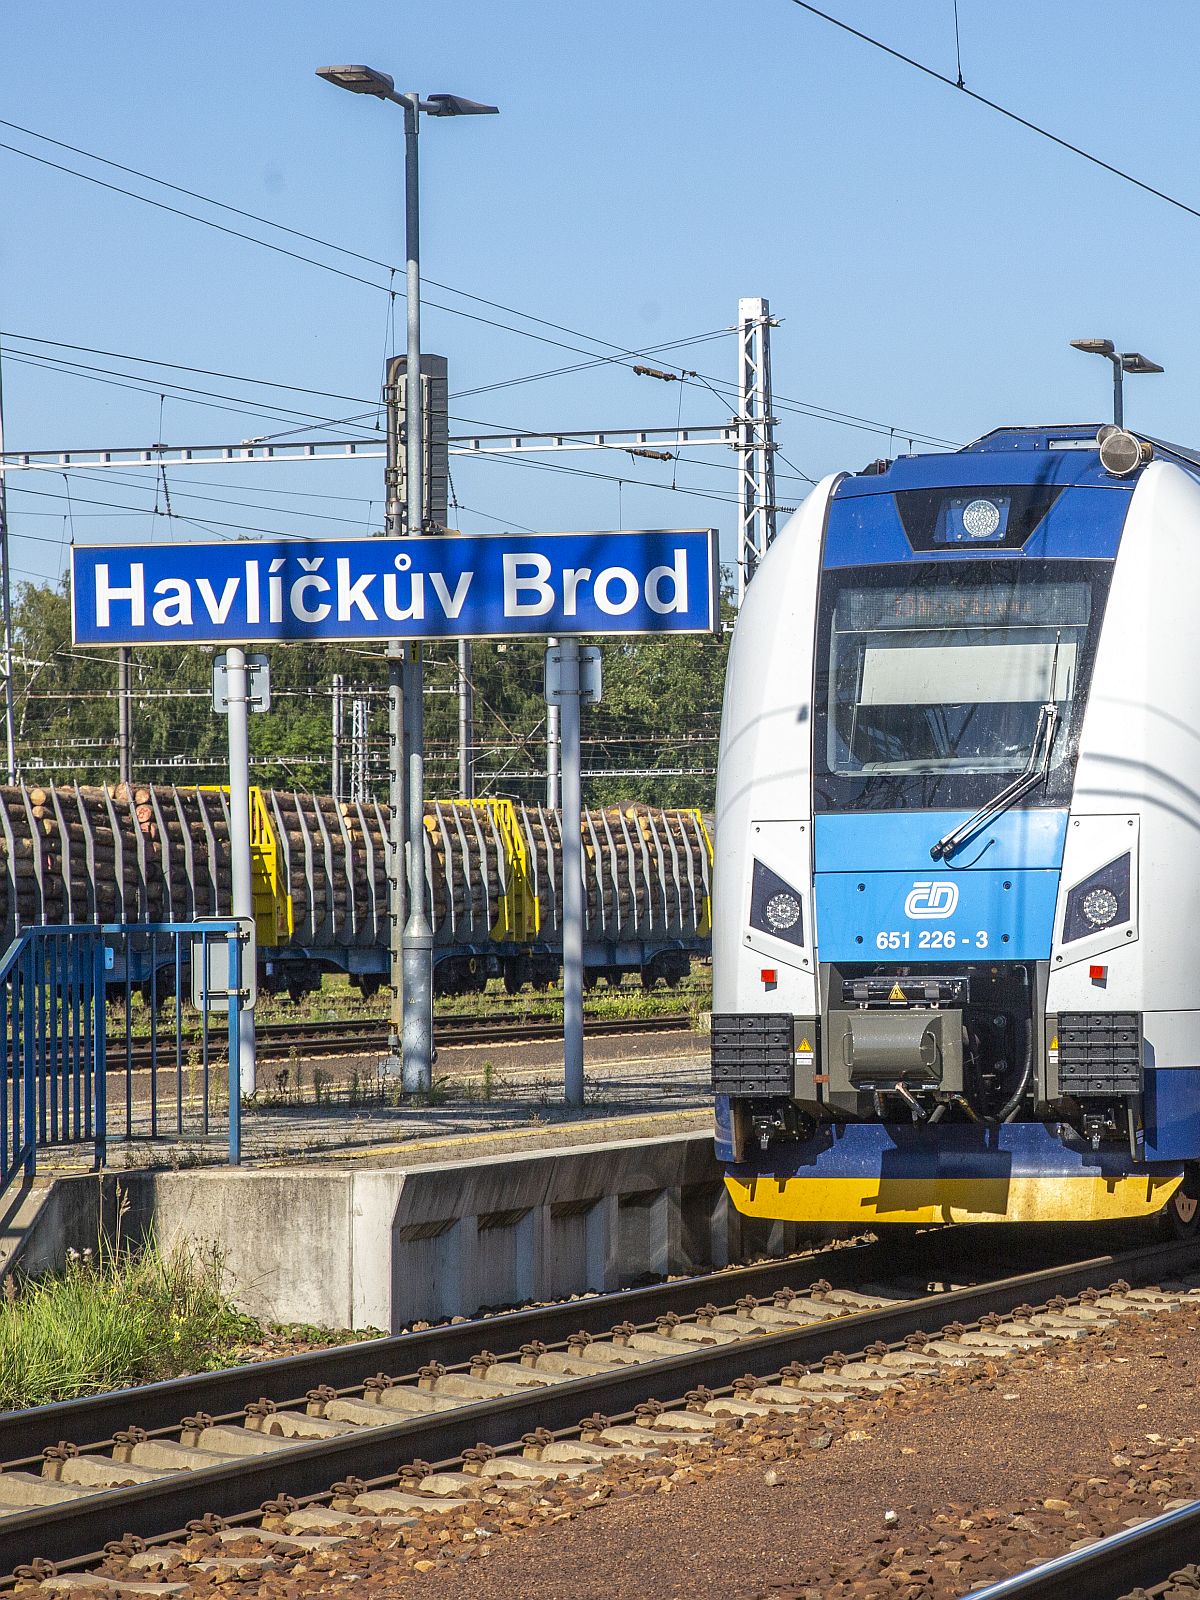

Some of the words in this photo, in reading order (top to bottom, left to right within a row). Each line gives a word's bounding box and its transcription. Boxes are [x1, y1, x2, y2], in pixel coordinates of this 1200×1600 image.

[94, 553, 475, 627] Havlíčkův
[502, 548, 689, 617] Brod
[876, 931, 910, 949] 651
[918, 930, 956, 949] 226
